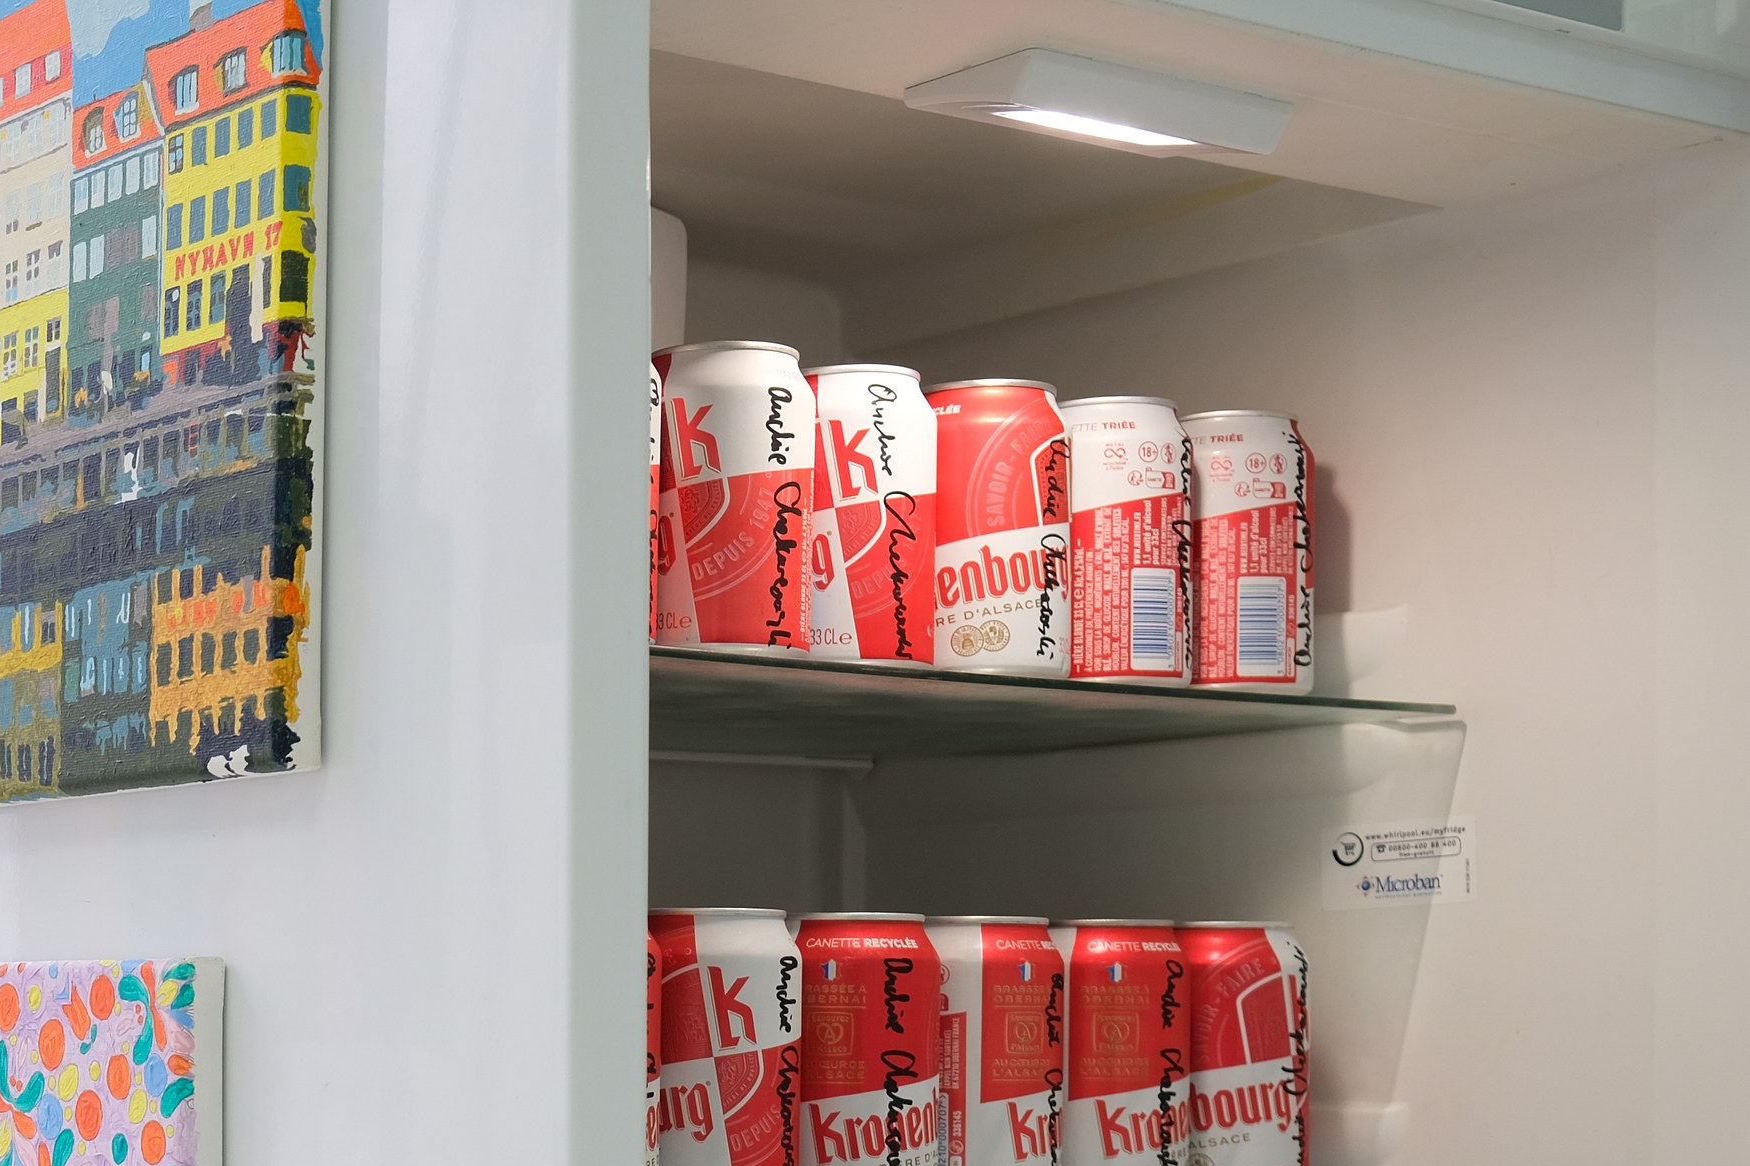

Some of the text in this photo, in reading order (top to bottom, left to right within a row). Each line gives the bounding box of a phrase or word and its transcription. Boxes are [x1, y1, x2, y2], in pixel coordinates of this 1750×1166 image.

[933, 404, 961, 416] CLÉE
[1102, 420, 1136, 430] TRIÉE
[672, 397, 723, 480] K
[1210, 433, 1243, 443] TRIÉE
[1142, 447, 1157, 458] 18+
[829, 420, 879, 501] K
[1250, 458, 1265, 469] 18+
[692, 532, 755, 581] DEPUIS
[853, 558, 907, 600] DEPUS
[1375, 873, 1441, 893] Microban
[806, 937, 919, 949] CANETTE RECYCLÉE
[996, 940, 1041, 950] CANETTE
[1087, 941, 1140, 951] CANETTE
[805, 983, 855, 993] RASSÉE
[807, 995, 866, 1004] BERNAI
[706, 966, 757, 1050] K
[730, 1104, 781, 1152] DEPUIS
[1189, 1132, 1251, 1151] ALSACE
